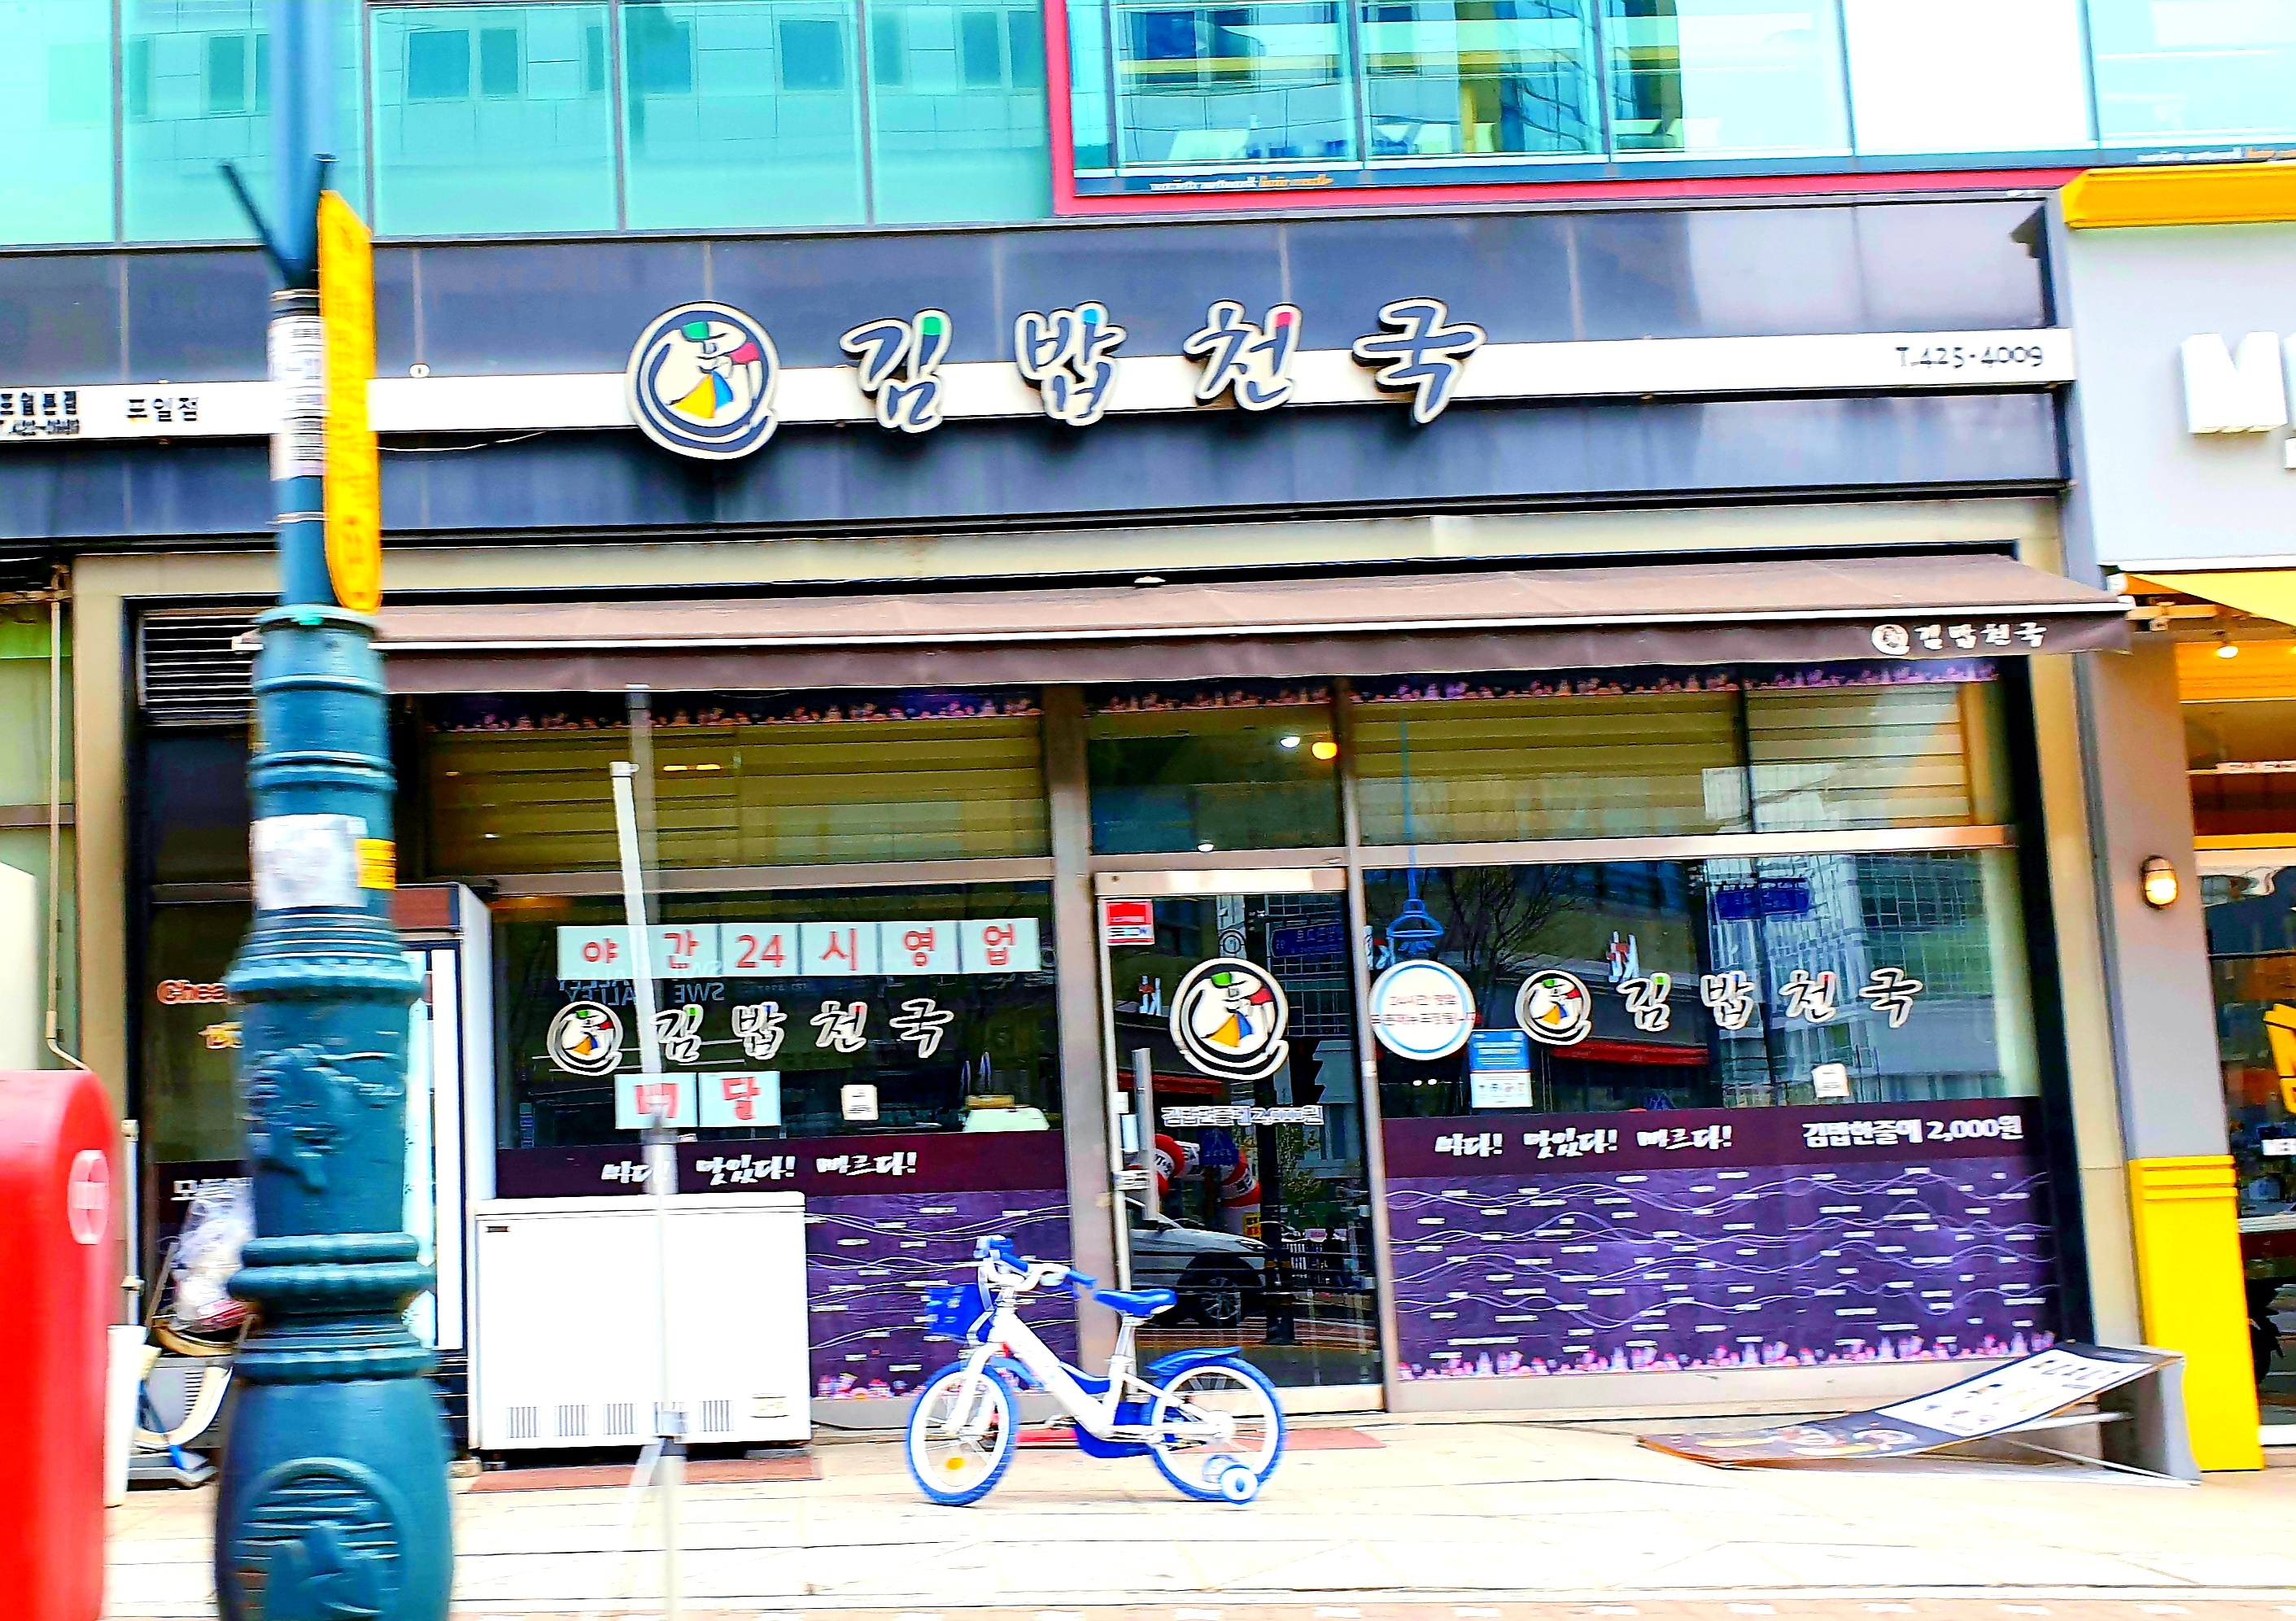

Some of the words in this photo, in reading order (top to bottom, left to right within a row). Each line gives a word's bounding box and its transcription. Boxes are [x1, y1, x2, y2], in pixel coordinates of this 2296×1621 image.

[840, 298, 1487, 434] 김밥천국
[1894, 346, 2044, 369] T.425-4009
[2180, 330, 2296, 434] M
[1914, 622, 2048, 650] 김밥천국
[651, 998, 954, 1063] 김밥천국
[1615, 967, 1924, 1032] 김밥천국
[1801, 1118, 1923, 1148] 김밥한줄에
[1926, 1115, 2024, 1143] 2,000원
